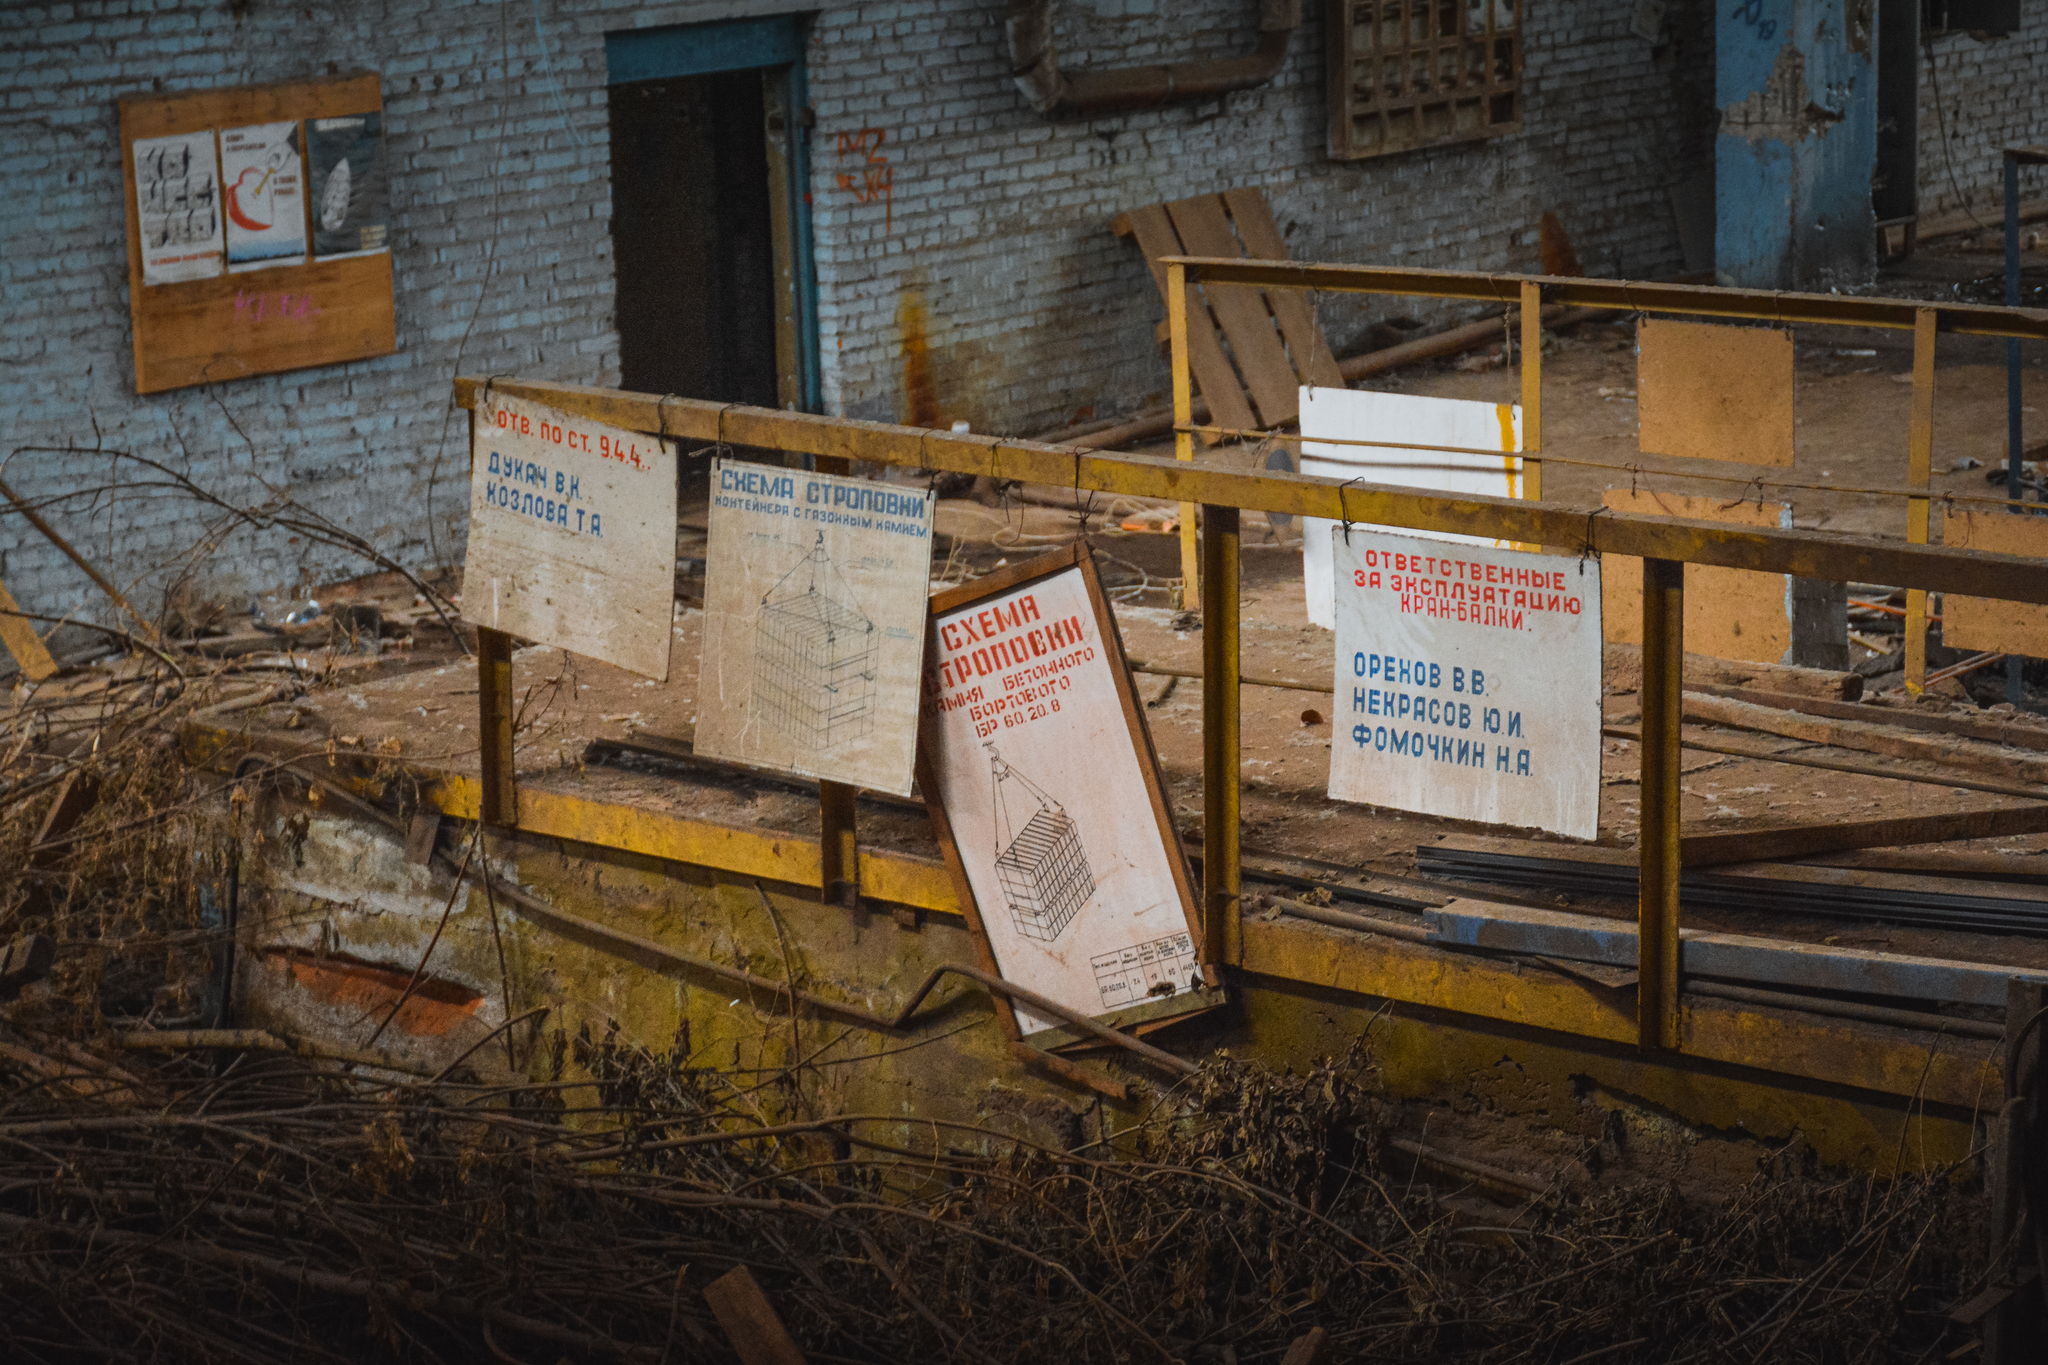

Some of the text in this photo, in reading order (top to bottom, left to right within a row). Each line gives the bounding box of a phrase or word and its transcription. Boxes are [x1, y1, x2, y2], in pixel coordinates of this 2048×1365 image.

[497, 410, 534, 436] ОТВ.
[541, 422, 562, 444] ПО
[568, 430, 592, 453] СТ.
[488, 451, 583, 500] ДУКАЧ В.К.
[721, 468, 924, 519] СХЕМА СТРОПОВКИ
[486, 481, 604, 538] КОЗЛОВА Т.А.
[715, 495, 927, 538] КОНТЕЙНЕРА С ГАЗОННЫМ КАМНЕМ
[1354, 569, 1582, 616] ЗА ЭКСПЛУАТАЦИЮ
[1365, 549, 1567, 592] ОТВЕТСТВЕННЫЕ
[941, 594, 1042, 651] СХЕМА
[1002, 646, 1095, 692] БЕТОННОГО
[1354, 651, 1490, 697] ОРЕХОВ В.В.
[969, 675, 1071, 722] БОРТОВОГО
[1353, 686, 1525, 739] НЕКРАСОВ Ю.И.
[975, 719, 999, 739] БР
[1352, 723, 1534, 777] ФОМОЧКИН Н.А.
